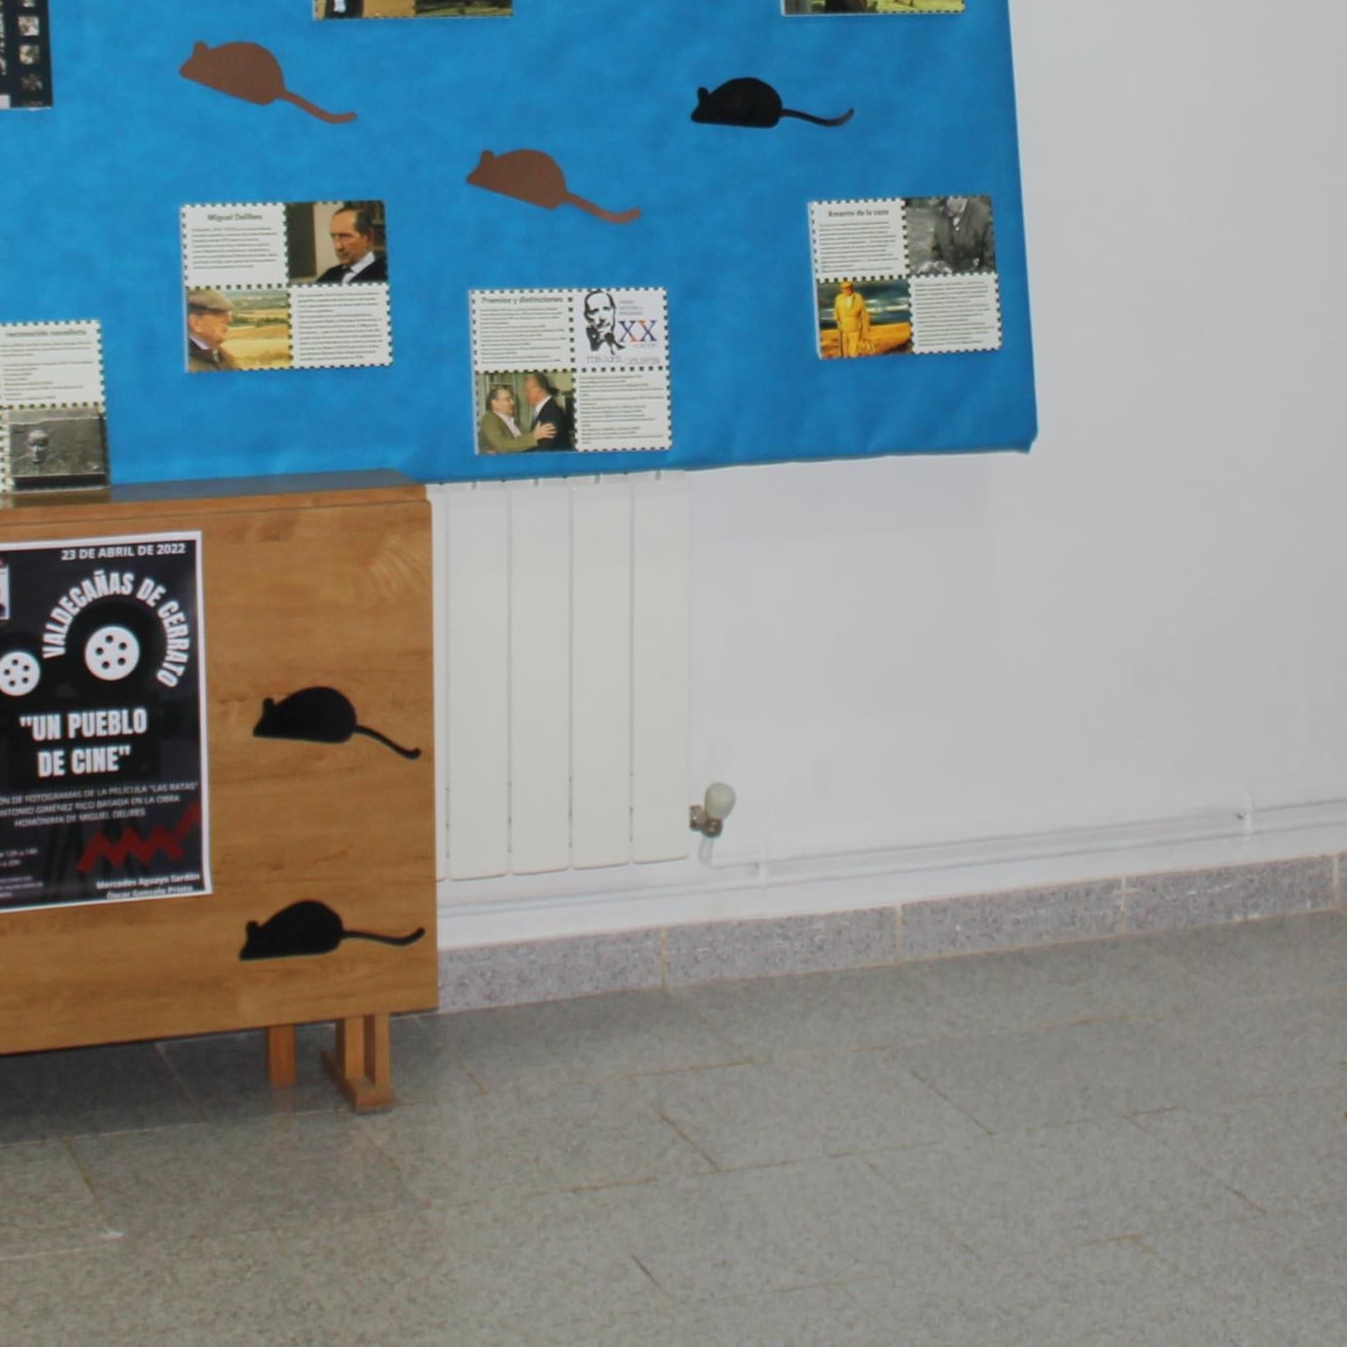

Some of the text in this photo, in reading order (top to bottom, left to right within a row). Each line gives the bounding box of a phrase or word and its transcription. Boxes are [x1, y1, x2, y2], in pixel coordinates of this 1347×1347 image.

[618, 320, 658, 342] XX
[61, 543, 186, 561] 23 DE ABRIL DE 2022
[42, 569, 191, 688] VALDECAÑAS DE CERRATO
[19, 708, 148, 741] "UN PUEBLO
[37, 745, 131, 778] DE CINE"
[11, 795, 23, 804] DE
[84, 788, 94, 798] DE
[97, 788, 107, 796] LA
[131, 797, 142, 805] EN
[144, 796, 154, 804] LA
[156, 794, 180, 803] OBRA
[65, 814, 76, 823] DE
[79, 811, 109, 821] MIGUEL
[96, 878, 137, 890] Mercedes
